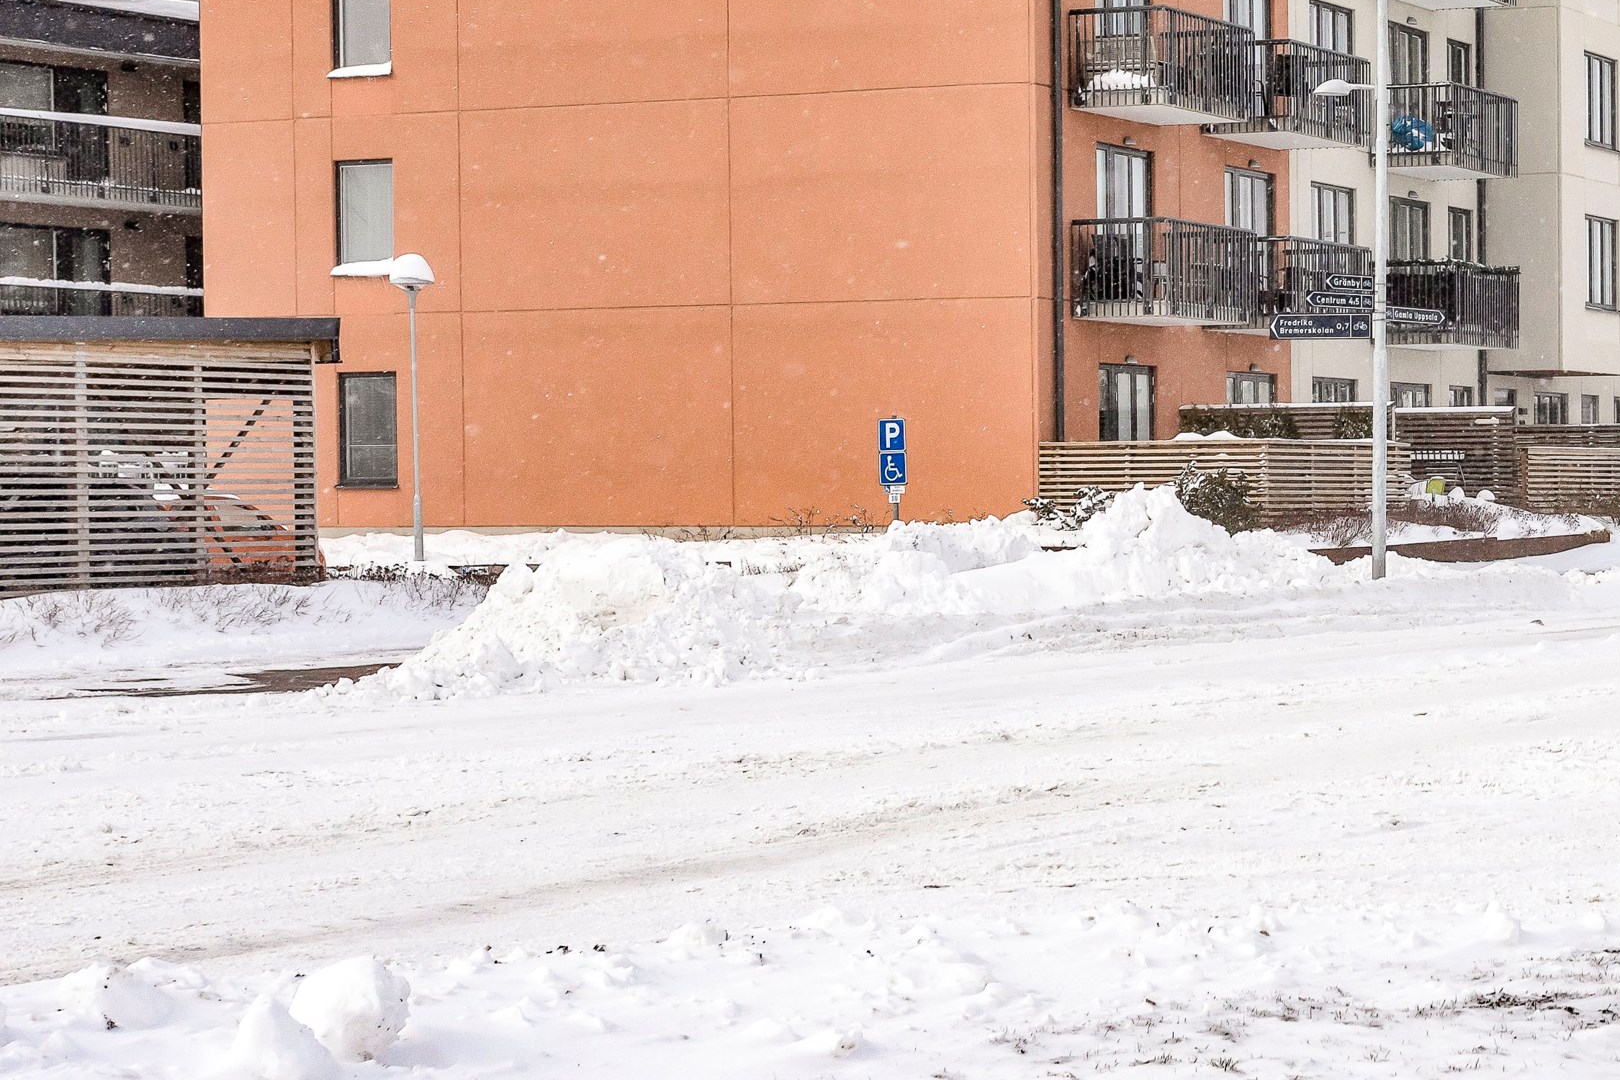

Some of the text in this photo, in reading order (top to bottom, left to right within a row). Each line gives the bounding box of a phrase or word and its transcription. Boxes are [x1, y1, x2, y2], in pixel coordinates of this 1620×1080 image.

[1333, 277, 1361, 289] Gränby
[1316, 295, 1347, 305] Centrum
[1394, 310, 1438, 322] Gamla Uppsala
[1279, 326, 1334, 334] Bremerskolan
[1336, 322, 1350, 331] 0,7
[885, 422, 900, 449] P
